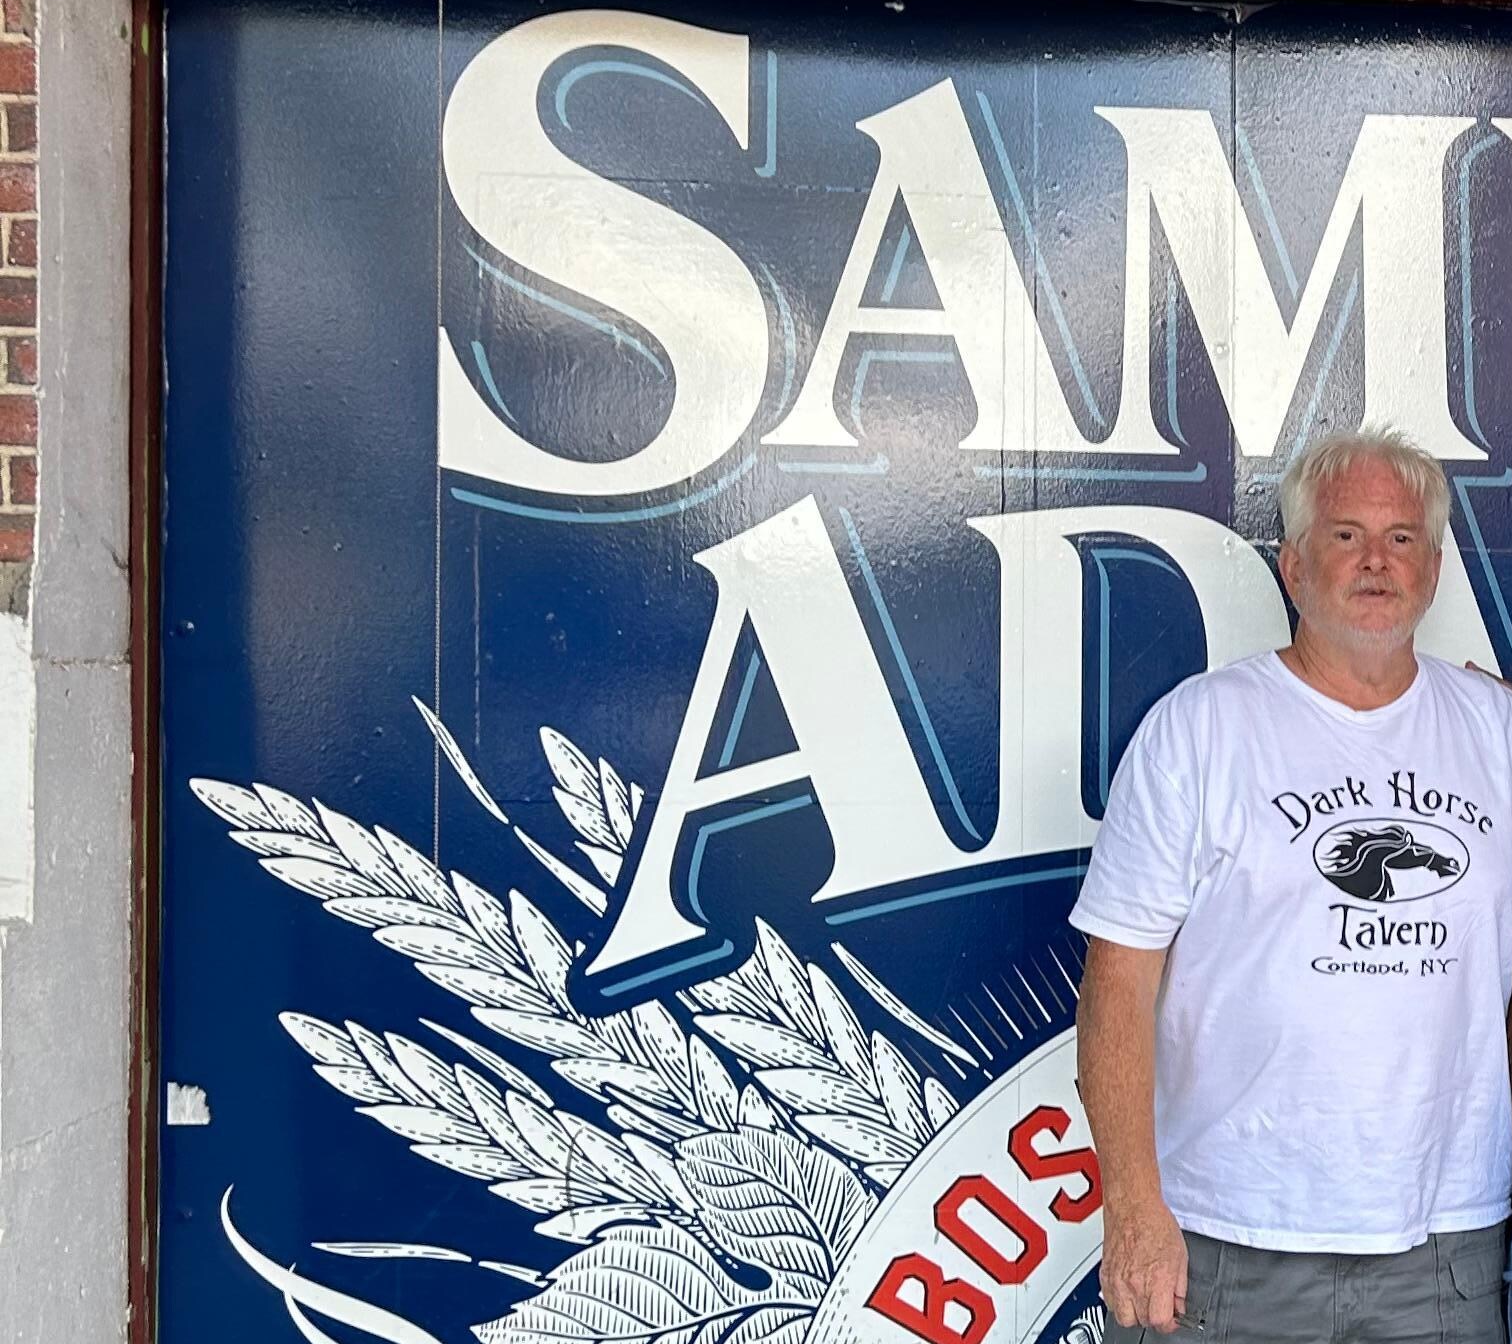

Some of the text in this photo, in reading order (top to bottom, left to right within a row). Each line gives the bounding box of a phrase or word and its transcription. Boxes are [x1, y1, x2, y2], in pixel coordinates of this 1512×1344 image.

[1271, 771, 1494, 844] Dark Horse
[1328, 903, 1448, 951] Tavern
[1311, 957, 1458, 977] Cortland, NY
